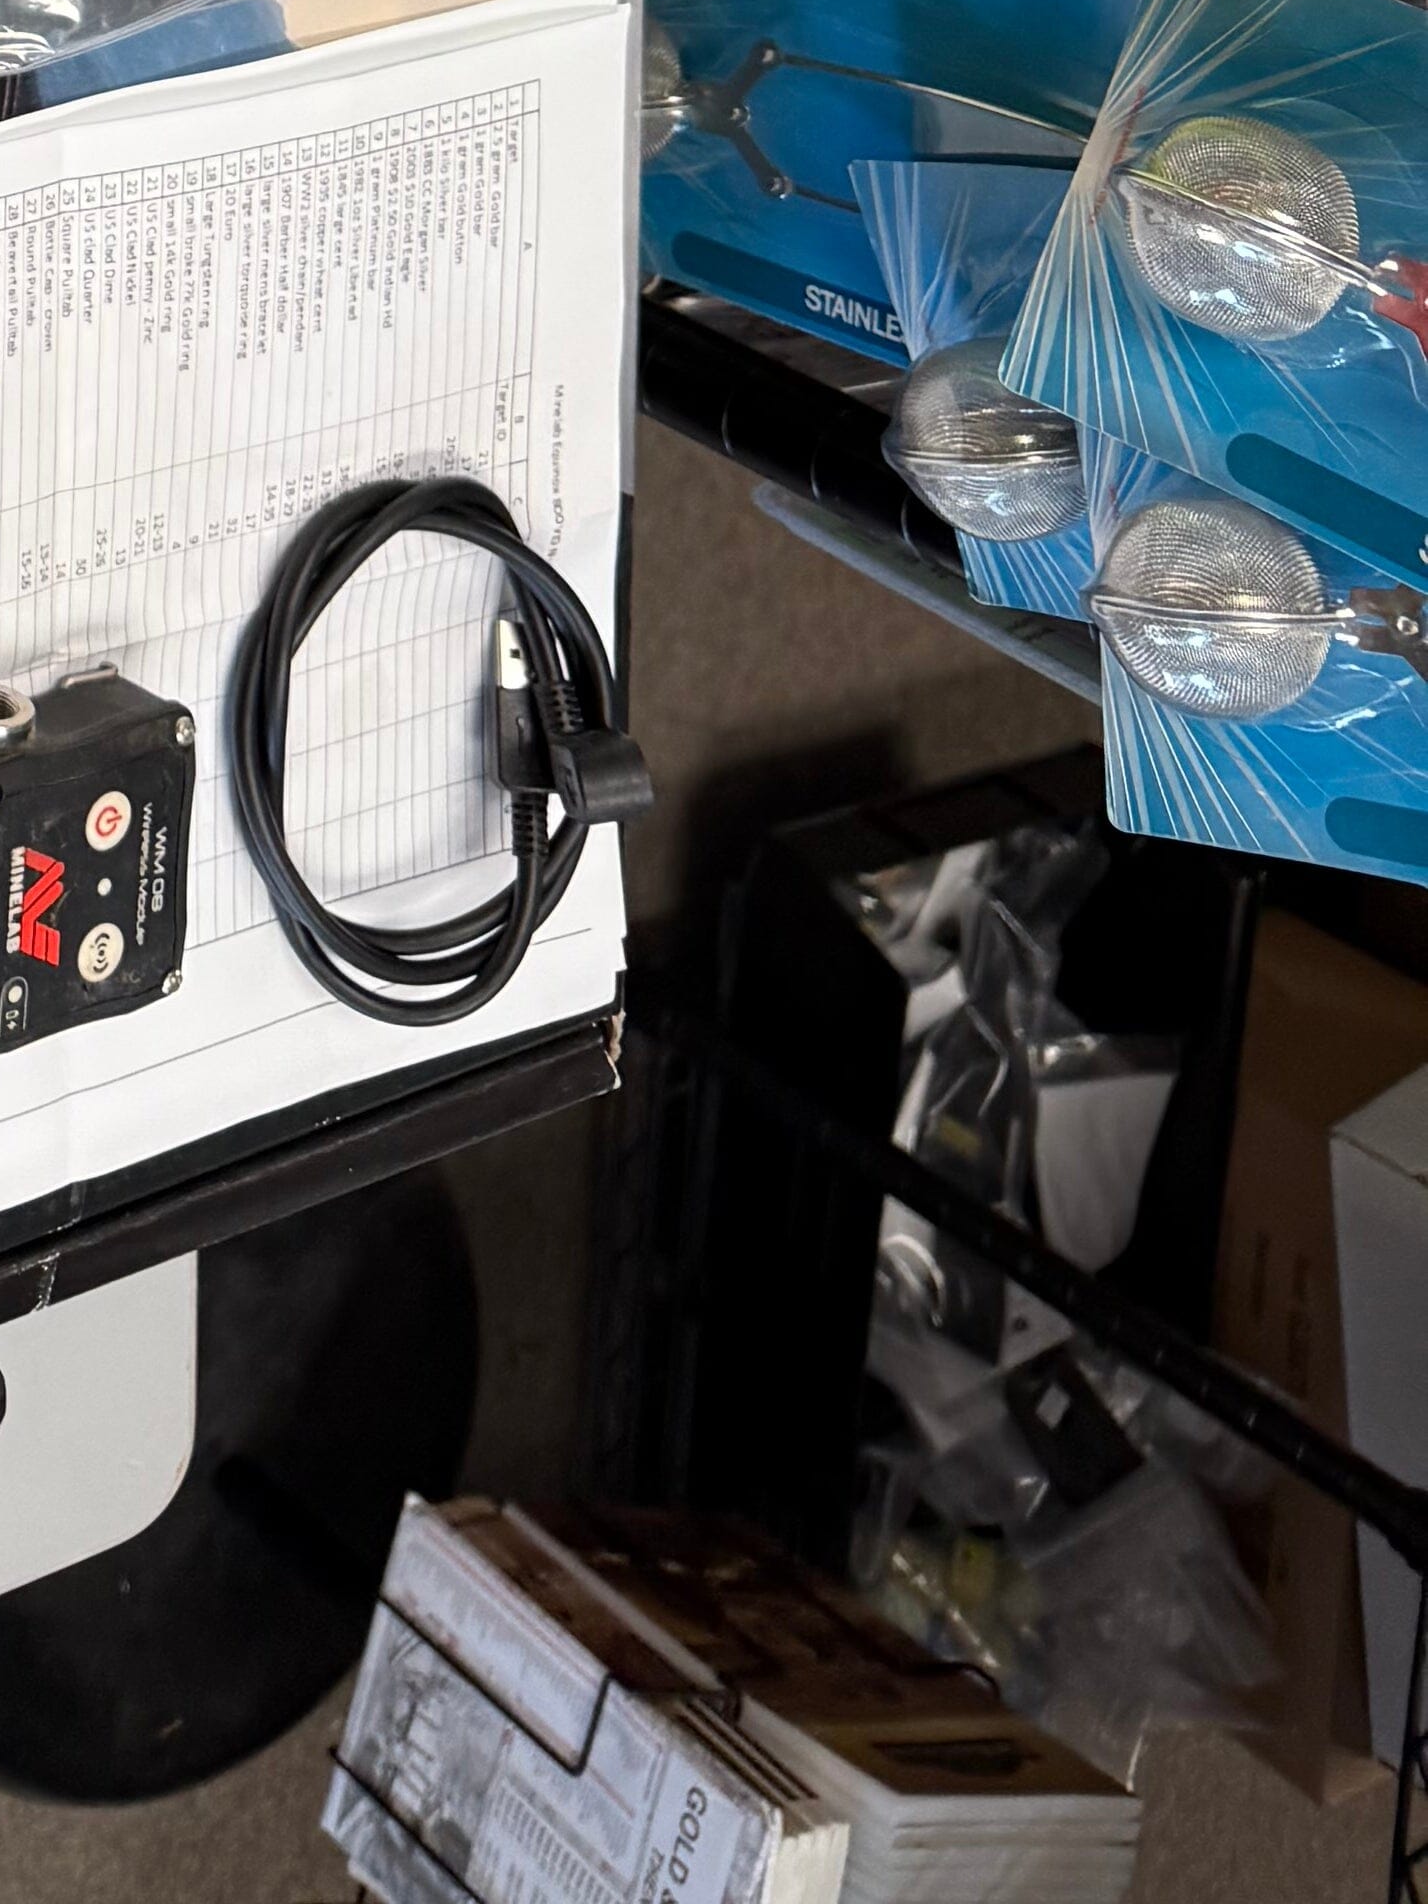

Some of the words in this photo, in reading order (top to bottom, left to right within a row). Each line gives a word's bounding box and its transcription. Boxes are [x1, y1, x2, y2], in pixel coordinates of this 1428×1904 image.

[202, 191, 216, 229] Large
[60, 215, 74, 265] Square
[139, 803, 153, 877] Wireless
[153, 826, 168, 875] WM
[5, 846, 26, 954] MINELAB
[135, 878, 149, 946] Module
[151, 878, 165, 912] 08
[668, 1786, 708, 1885] GOLD
